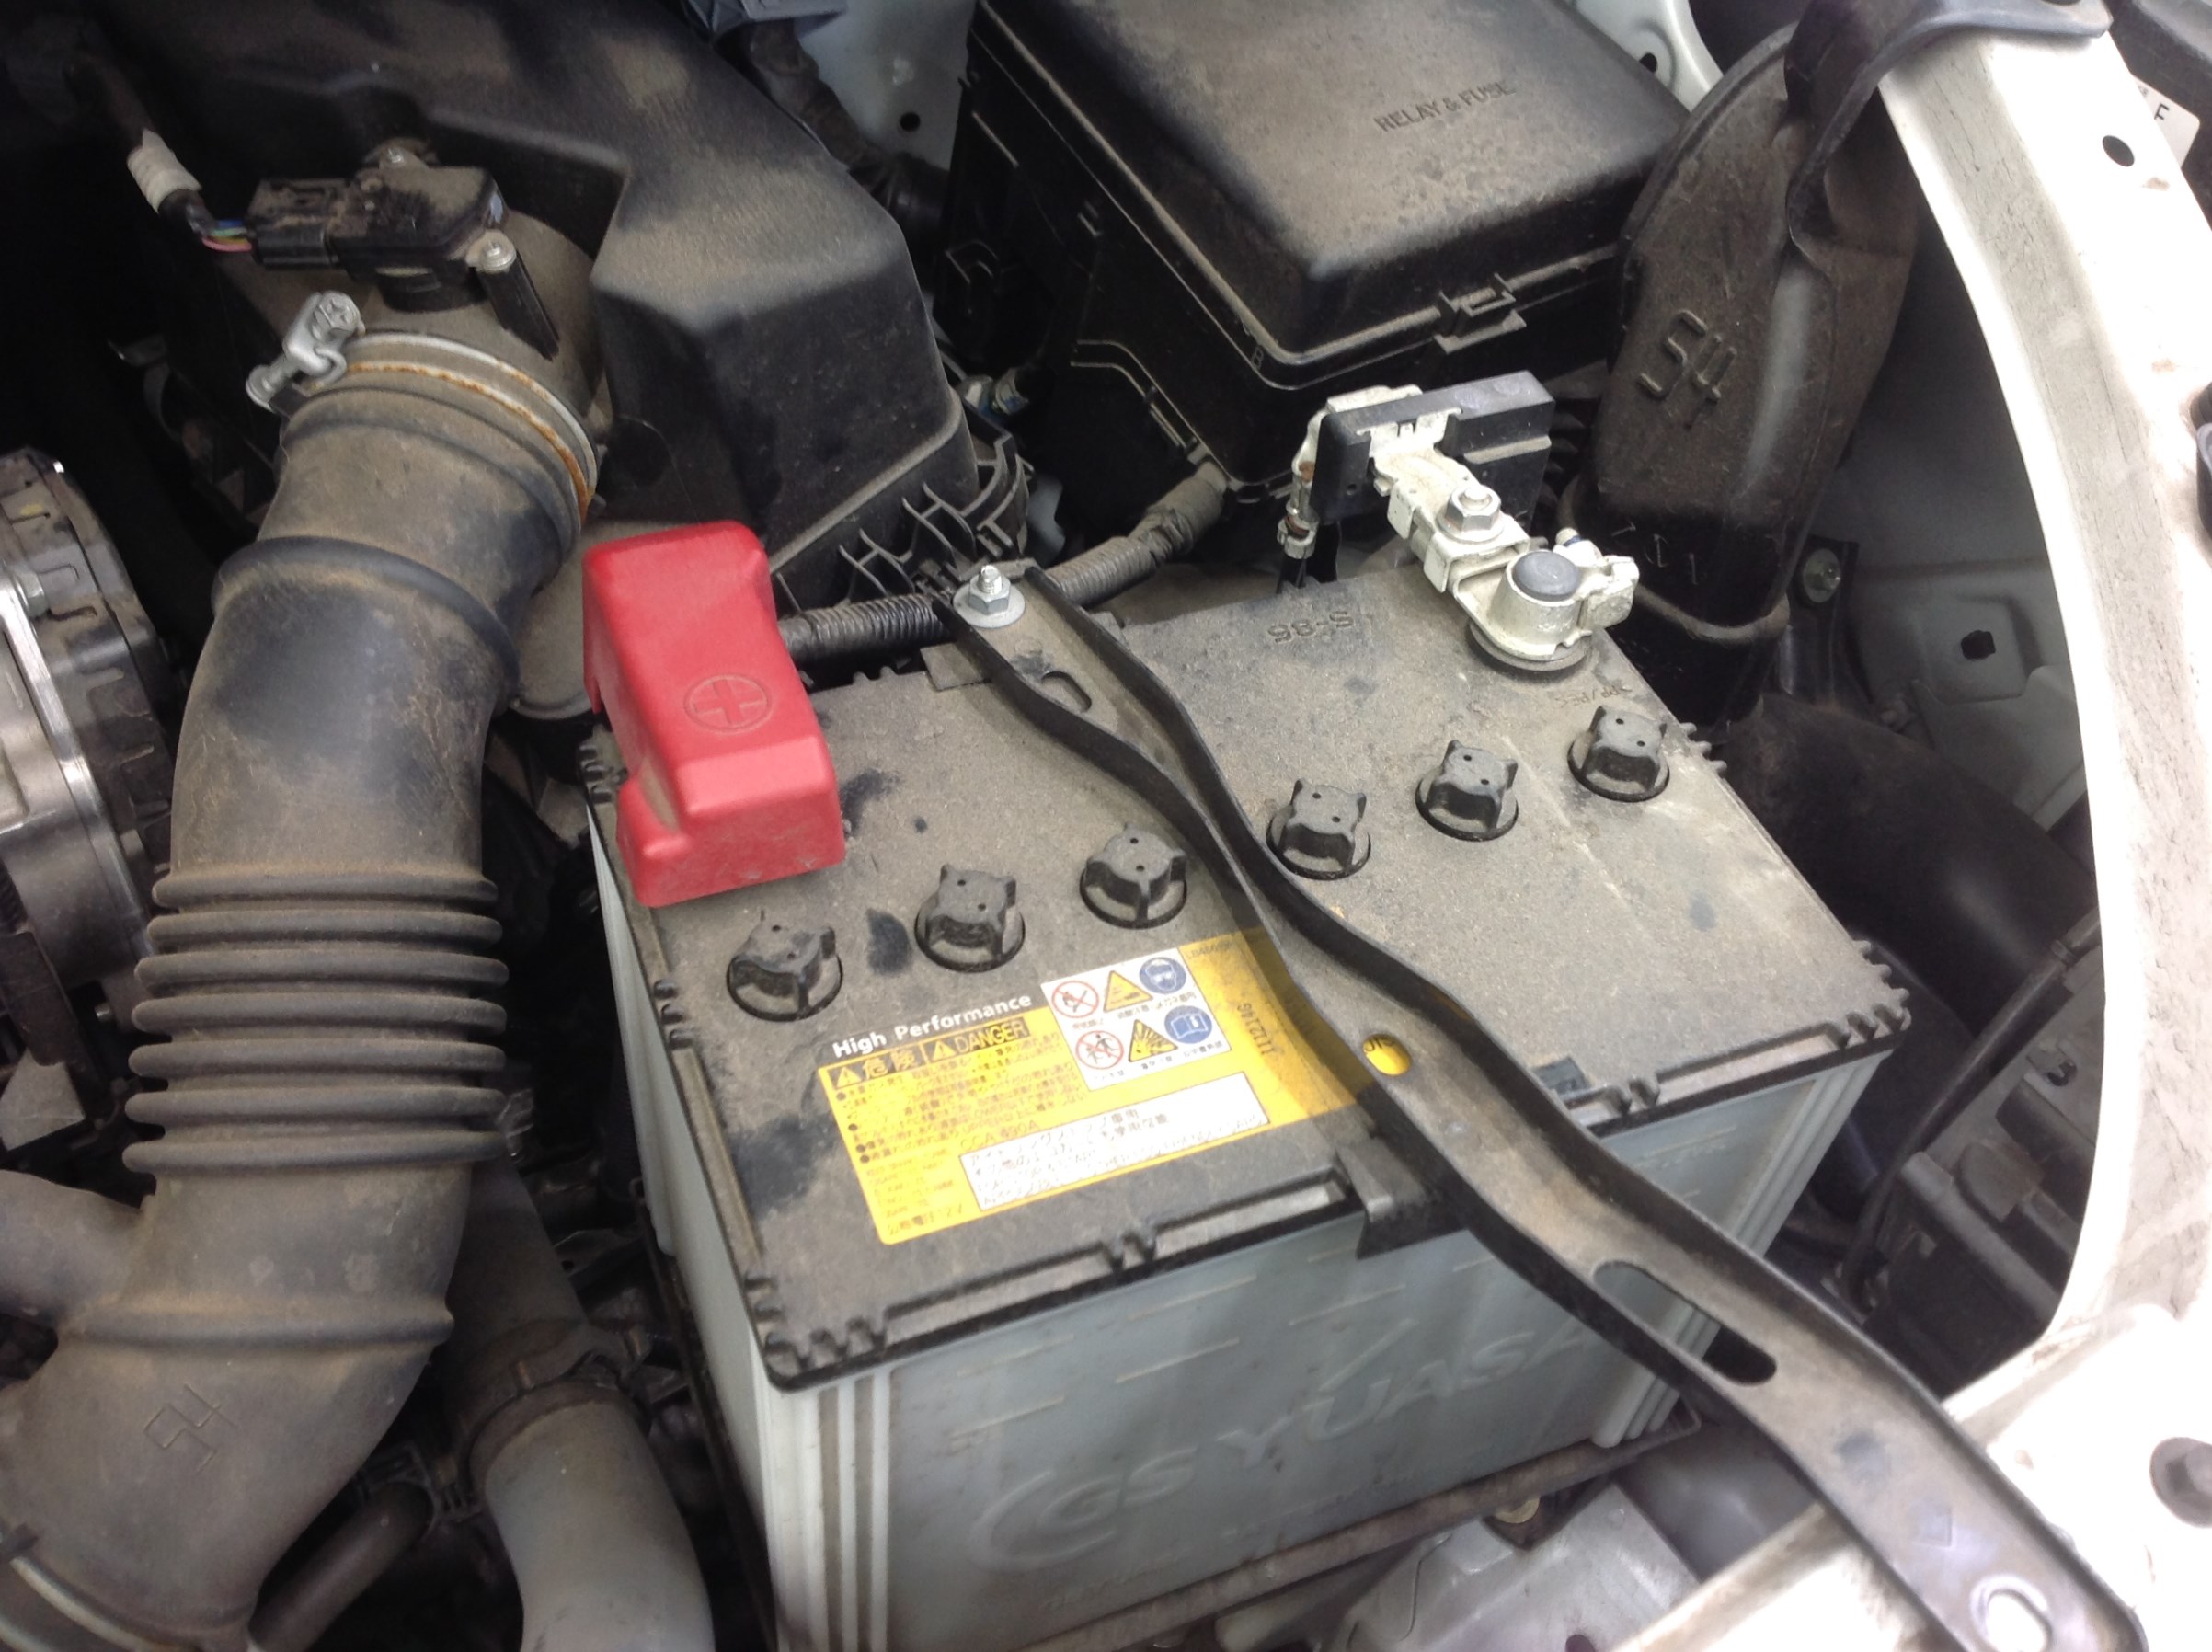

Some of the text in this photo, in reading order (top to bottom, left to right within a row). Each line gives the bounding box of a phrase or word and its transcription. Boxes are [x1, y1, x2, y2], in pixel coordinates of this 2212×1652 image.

[1372, 81, 1517, 132] RELAY & FUSE
[833, 993, 1032, 1059] High Performance
[956, 1018, 1027, 1054] DANGER
